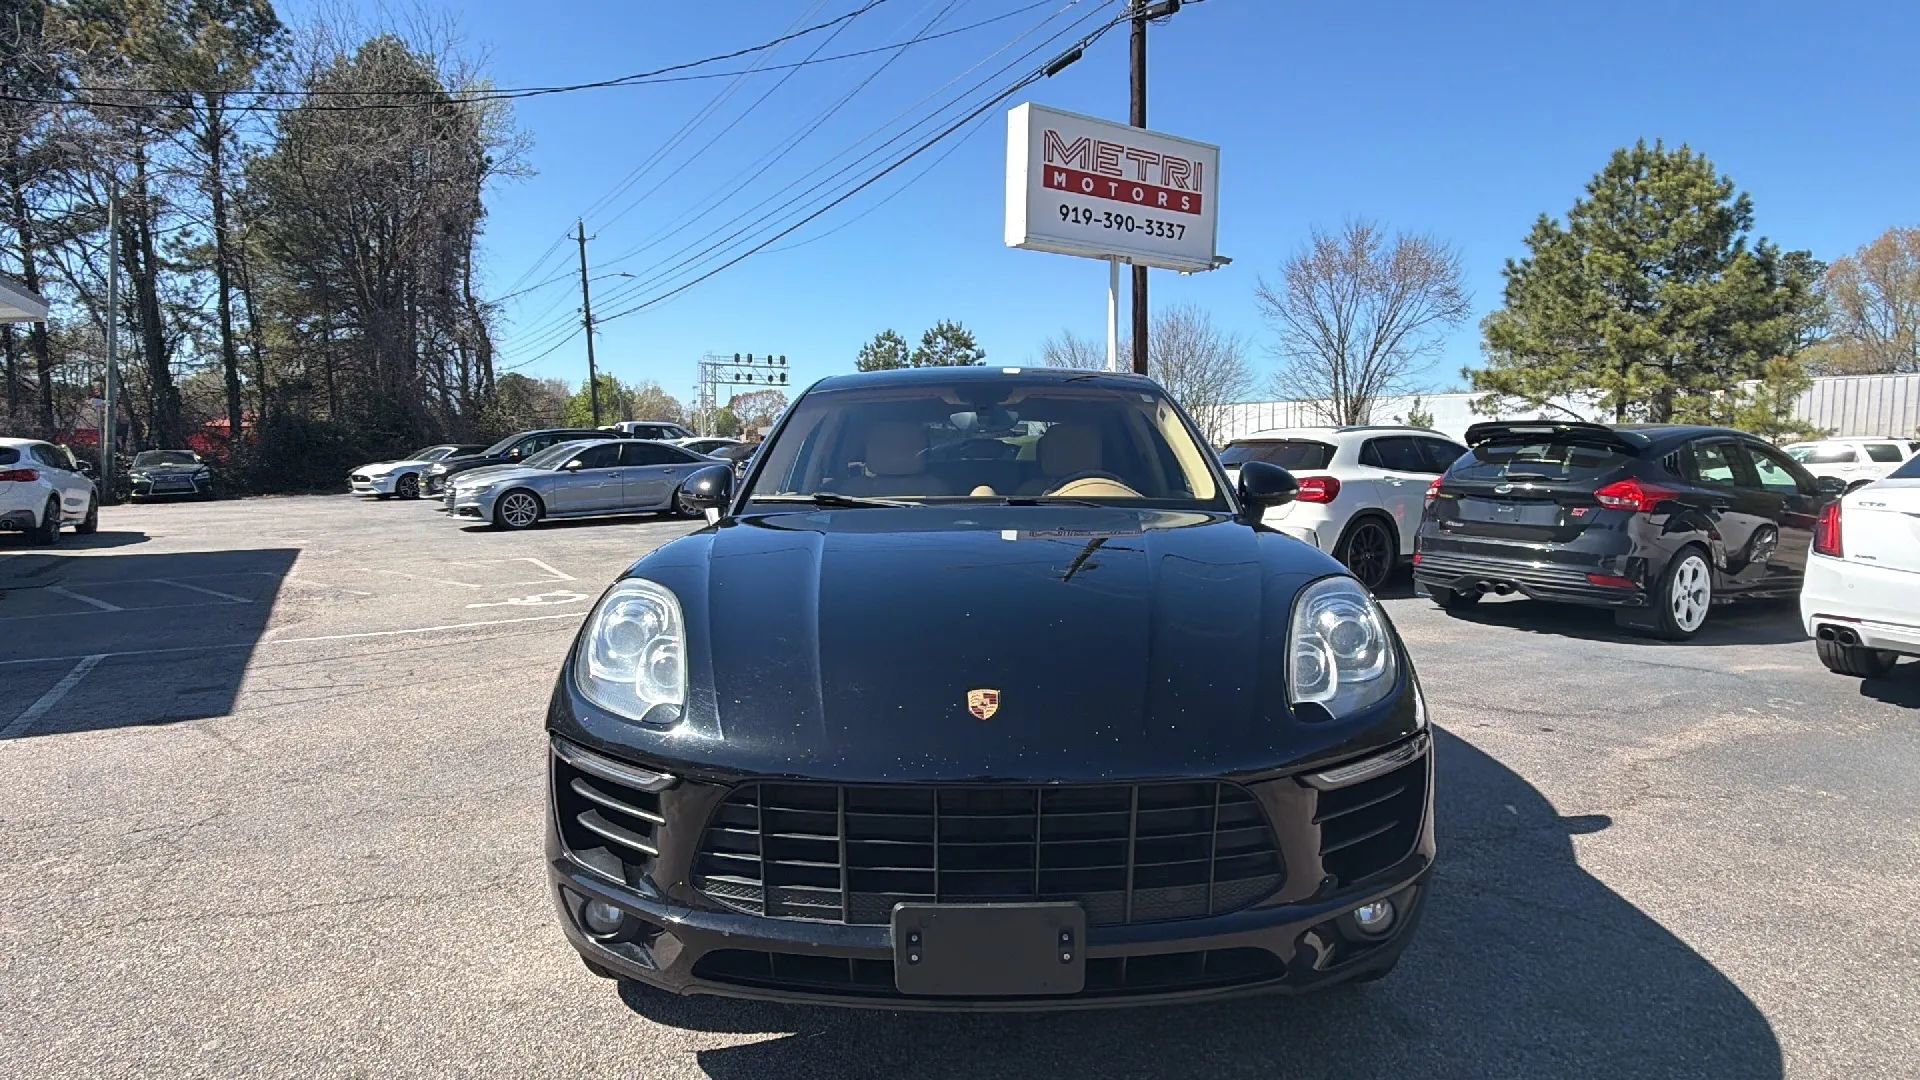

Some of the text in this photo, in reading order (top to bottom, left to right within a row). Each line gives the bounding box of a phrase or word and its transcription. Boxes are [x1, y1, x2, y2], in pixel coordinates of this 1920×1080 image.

[1043, 129, 1203, 191] METRI
[1053, 171, 1191, 211] MOTORS
[1059, 204, 1186, 241] 919-390-3337
